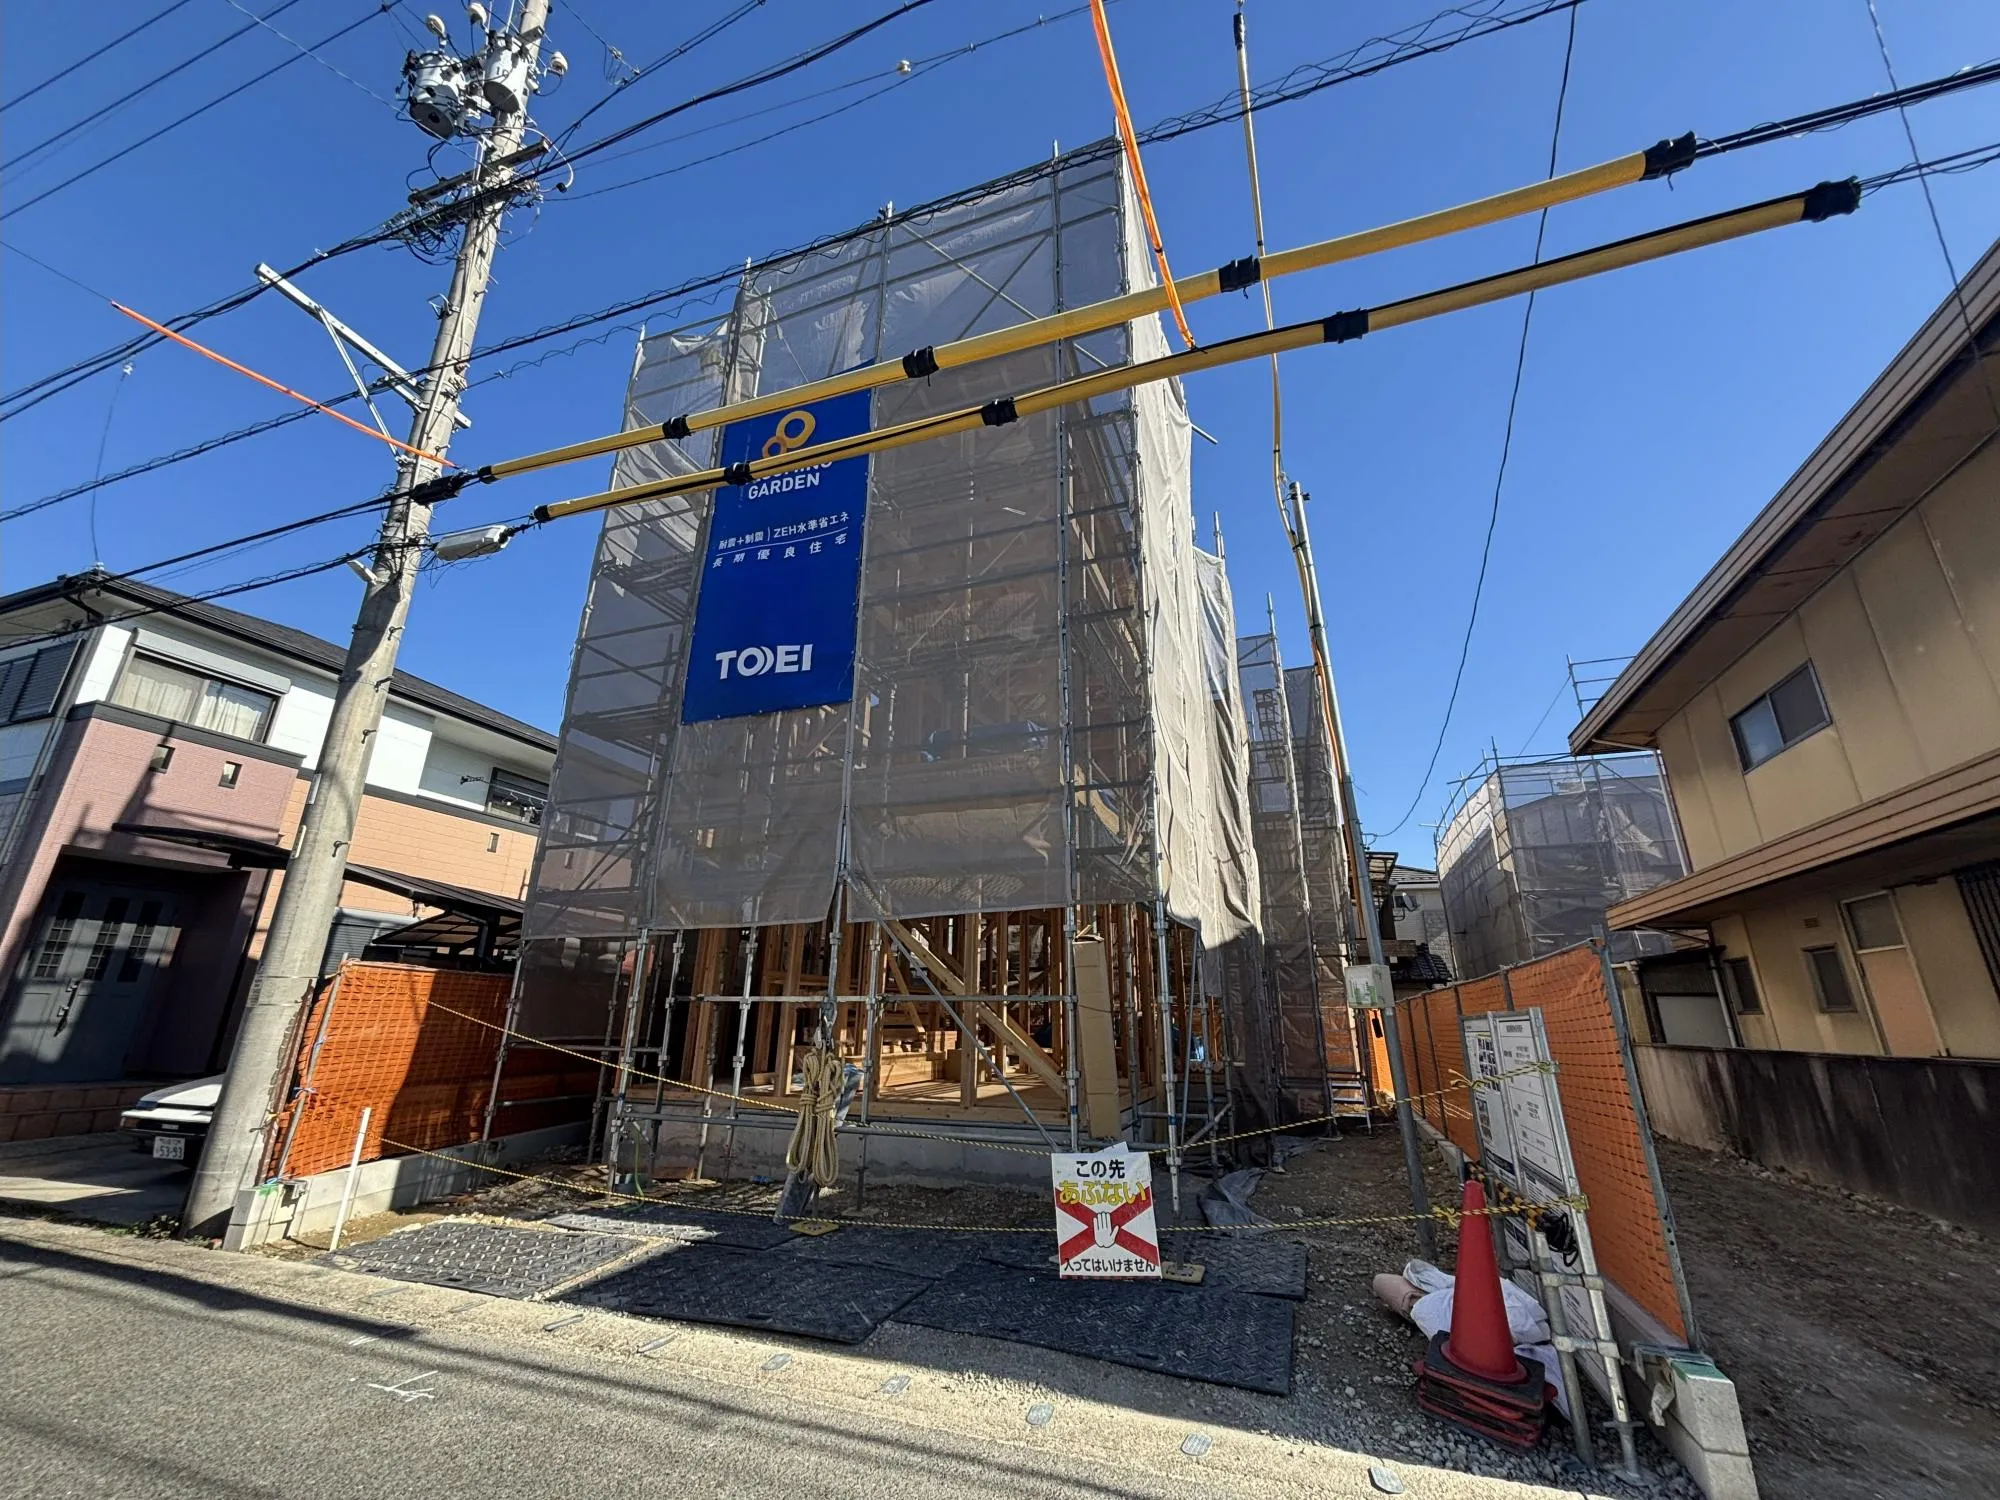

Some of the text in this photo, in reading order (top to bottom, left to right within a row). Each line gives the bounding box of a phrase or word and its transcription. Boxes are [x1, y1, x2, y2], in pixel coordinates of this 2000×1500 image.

[748, 472, 820, 500] GARDEN
[712, 533, 848, 569] 長期優良住宅
[715, 643, 814, 681] TOEI
[1076, 1159, 1125, 1178] この先
[1059, 1180, 1146, 1204] あぶない
[1063, 1258, 1156, 1273] 入ってはいけません
